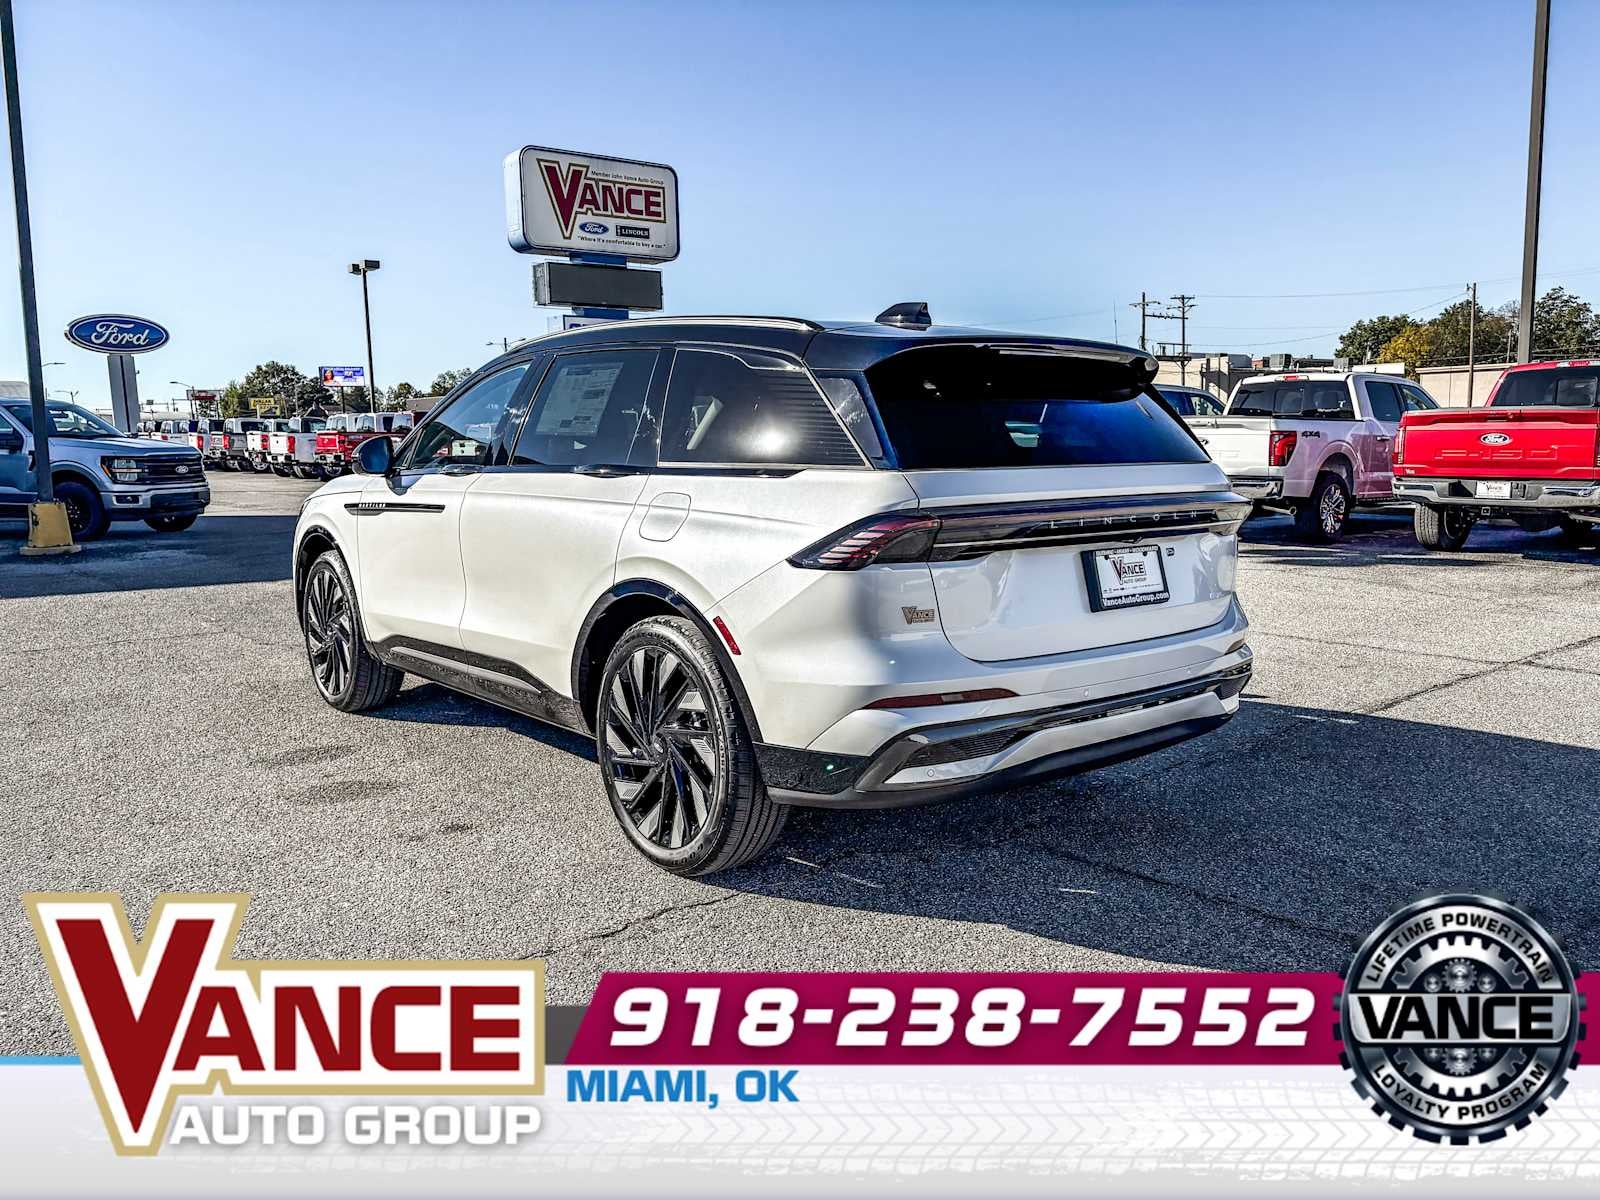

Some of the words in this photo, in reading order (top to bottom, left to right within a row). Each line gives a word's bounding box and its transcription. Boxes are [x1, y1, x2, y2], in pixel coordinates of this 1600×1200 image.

[543, 164, 662, 235] VANCE
[584, 223, 604, 233] Ford
[90, 321, 150, 346] Ford
[1050, 510, 1197, 529] LINCOLN
[1110, 557, 1146, 584] VANCE
[1101, 591, 1169, 607] VanceAutoGroup.com
